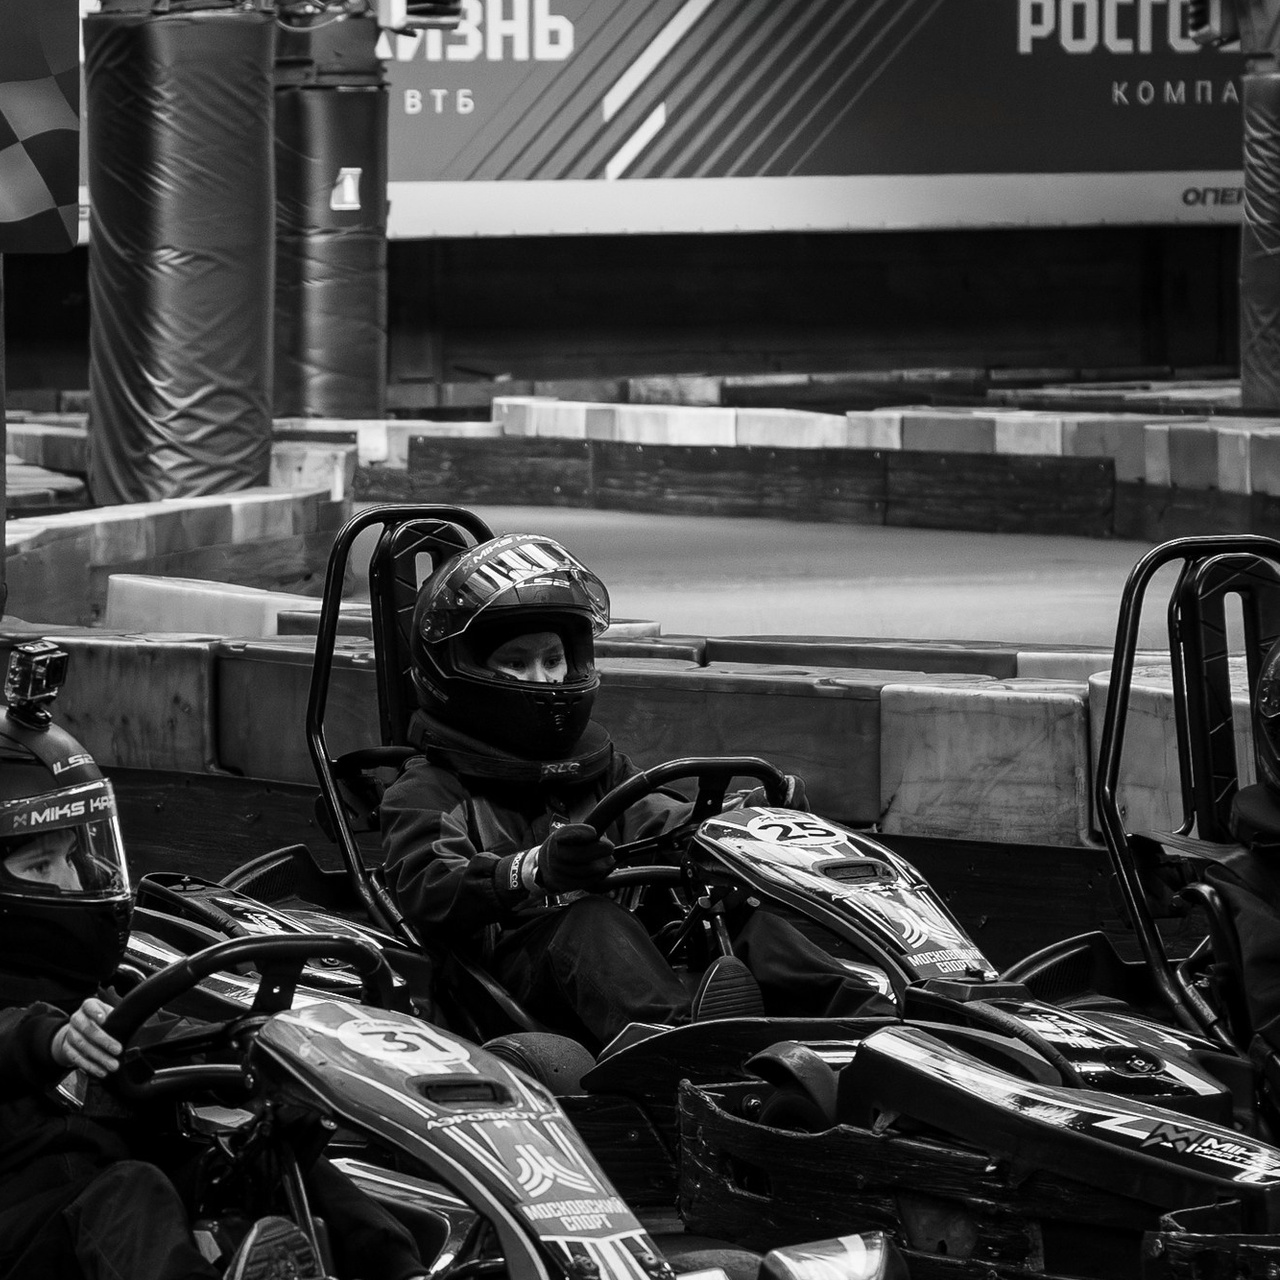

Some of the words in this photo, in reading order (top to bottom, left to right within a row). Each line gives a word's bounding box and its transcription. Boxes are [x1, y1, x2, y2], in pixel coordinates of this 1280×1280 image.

[404, 88, 475, 115] ВТБ
[1111, 79, 1240, 106] КОМПА
[30, 800, 86, 826] MIKS
[757, 821, 837, 842] 25
[359, 1030, 452, 1053] 31
[522, 1197, 629, 1221] МОСКОВСКИЙ
[560, 1213, 613, 1231] СПОРТ
